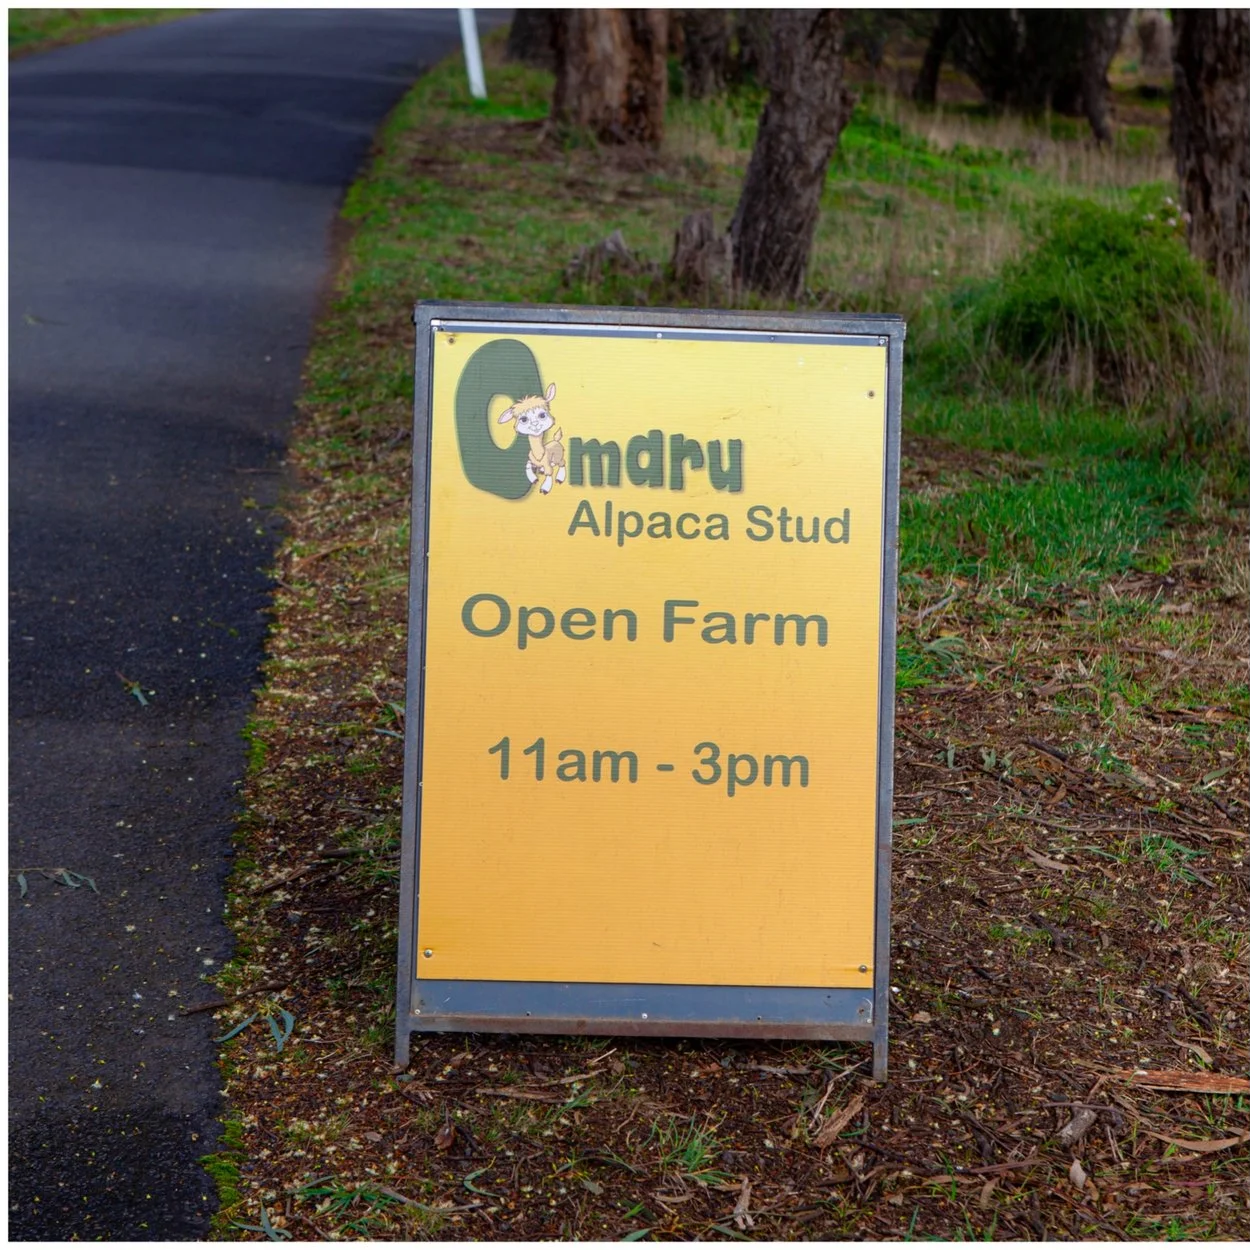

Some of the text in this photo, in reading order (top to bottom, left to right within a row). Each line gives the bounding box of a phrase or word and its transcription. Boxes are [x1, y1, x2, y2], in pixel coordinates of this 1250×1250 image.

[454, 338, 744, 500] Omaru
[567, 500, 851, 547] Alpaca Stud
[461, 593, 829, 650] Open Farm
[488, 737, 638, 783] 11am
[691, 741, 809, 797] 3pm
